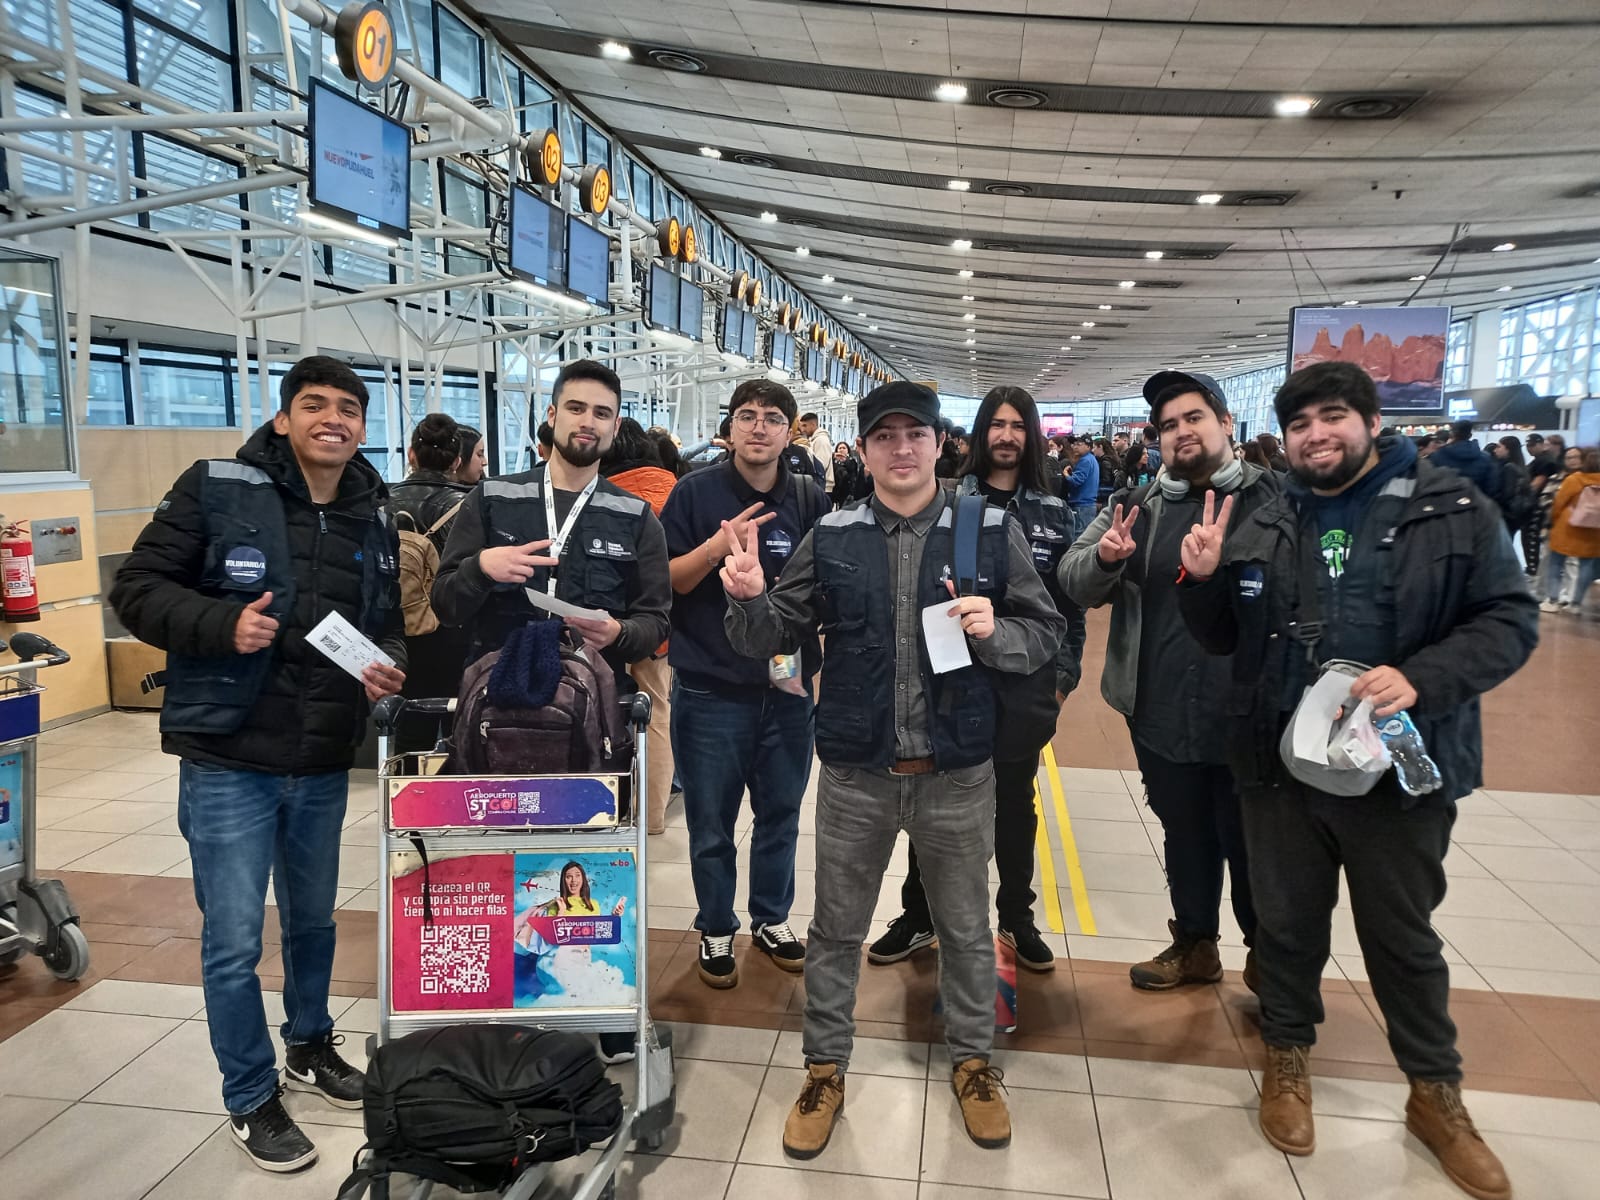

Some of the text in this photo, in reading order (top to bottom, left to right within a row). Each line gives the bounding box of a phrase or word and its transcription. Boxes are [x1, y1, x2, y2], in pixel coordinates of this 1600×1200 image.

[363, 26, 387, 67] 01
[546, 145, 558, 175] 02
[594, 178, 607, 202] 03
[465, 882, 474, 893] el
[477, 882, 491, 894] QR
[403, 893, 506, 907] y copra sin perder
[443, 905, 452, 916] ni
[456, 905, 485, 916] hacer
[486, 904, 508, 915] filas
